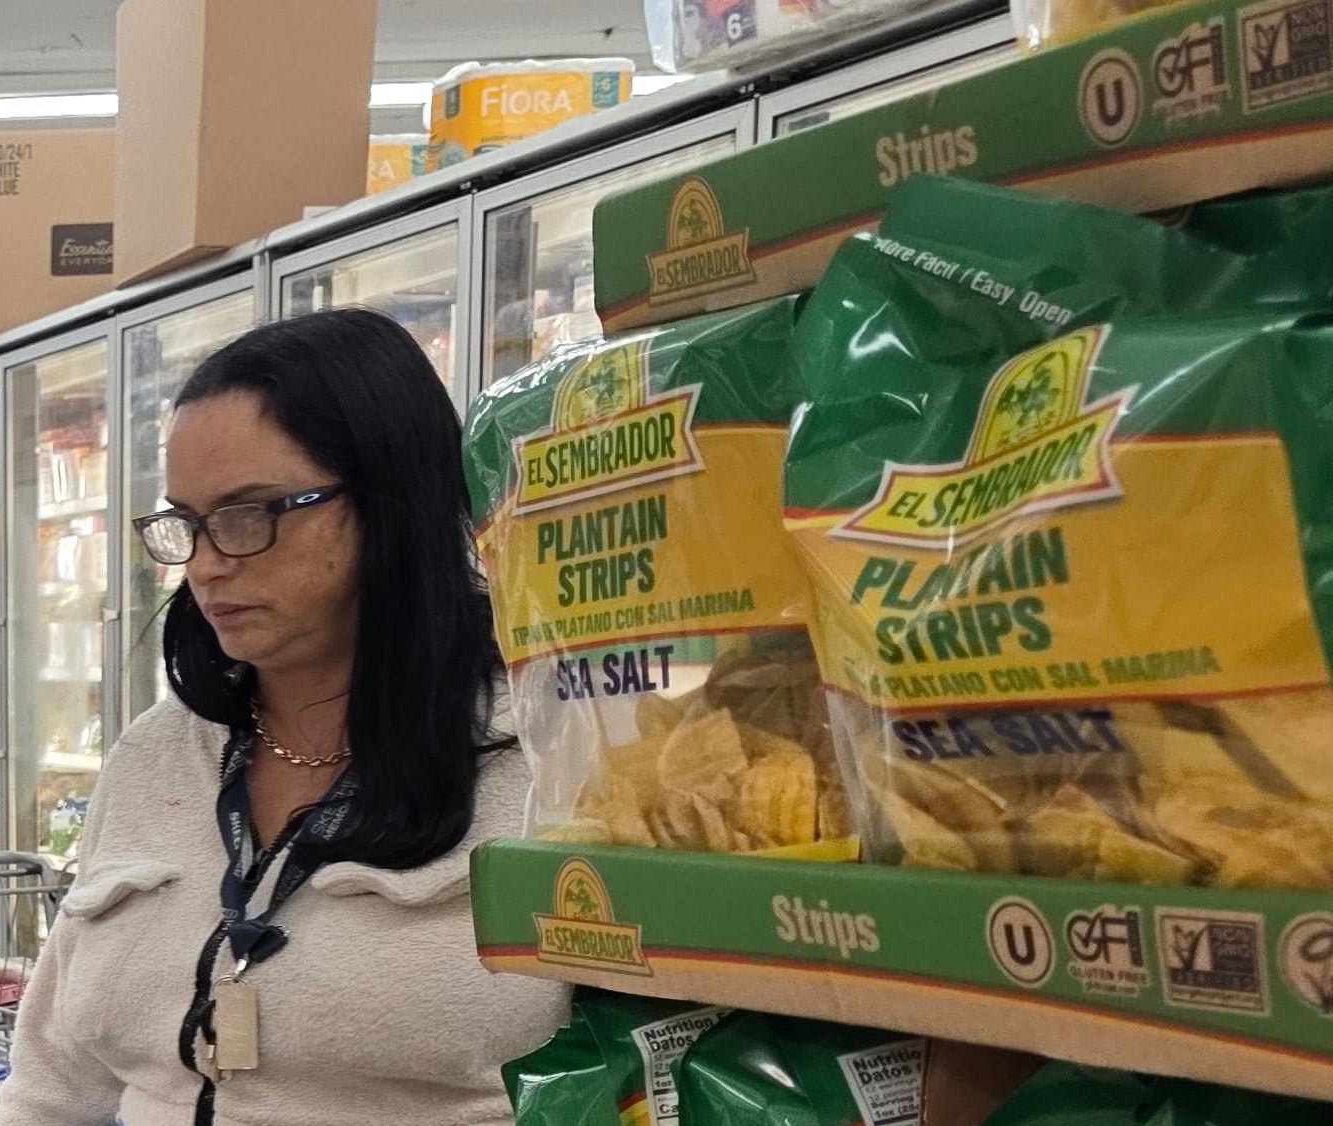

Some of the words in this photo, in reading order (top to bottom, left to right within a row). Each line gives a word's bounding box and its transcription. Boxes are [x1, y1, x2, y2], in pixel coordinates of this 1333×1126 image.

[876, 124, 979, 188] Strips
[665, 243, 742, 288] SEMBRADOR
[970, 271, 1016, 307] Easy
[1018, 290, 1073, 328] Open
[528, 456, 544, 487] EL
[545, 411, 677, 488] SEMBRADOR
[887, 490, 923, 521] EL
[918, 422, 1097, 529] SEMBRADOR
[537, 494, 669, 565] PLANTAIN
[557, 549, 656, 608] STRIPS
[555, 612, 613, 638] PLATANO
[615, 607, 644, 630] CON
[647, 602, 677, 625] SAL
[679, 588, 756, 621] MARINA
[875, 596, 1053, 666] STRIPS
[556, 652, 597, 701] SEA
[602, 645, 675, 698] SALT
[886, 671, 989, 700] PLATANO
[990, 665, 1046, 694] CON
[1046, 659, 1100, 690] SAL
[1101, 646, 1223, 685] MARINA
[891, 715, 994, 762] SEA
[988, 705, 1125, 757] SALT
[554, 926, 633, 961] SEMBRADOR
[772, 894, 881, 960] Strips
[1004, 922, 1035, 965] U
[643, 1014, 715, 1042] Nutrition
[649, 1033, 694, 1053] Datos
[851, 1049, 922, 1073] Nutritio
[859, 1066, 913, 1086] Datos
